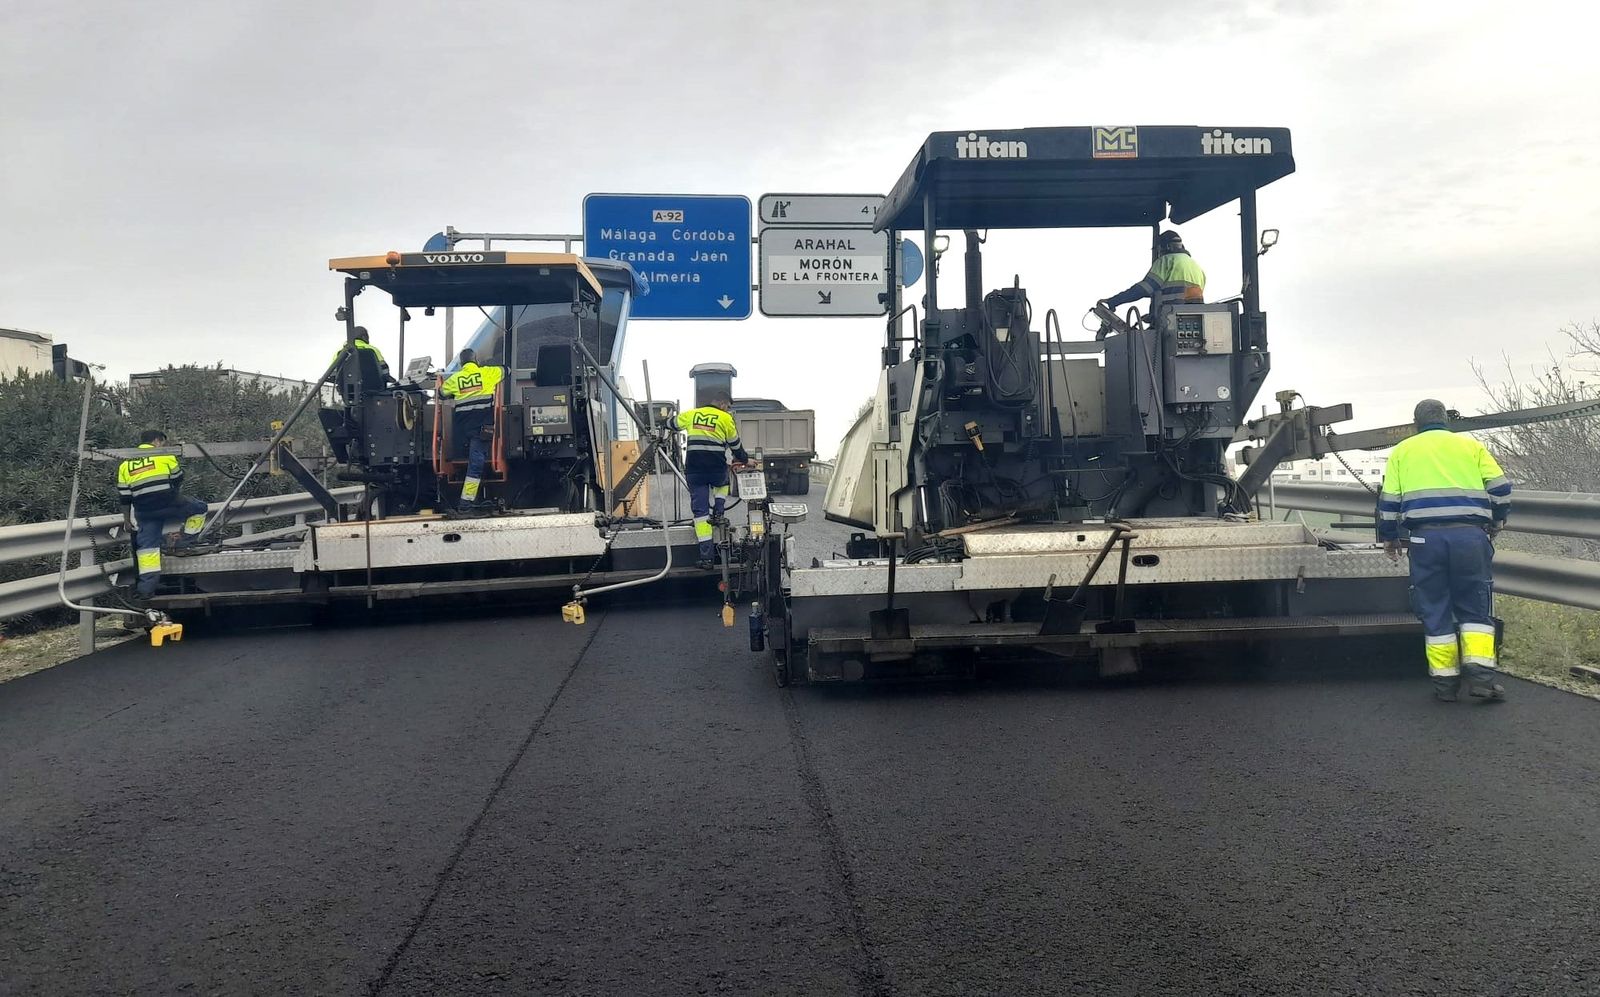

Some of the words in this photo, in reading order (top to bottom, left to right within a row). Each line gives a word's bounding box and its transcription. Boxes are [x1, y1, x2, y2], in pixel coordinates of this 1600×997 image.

[955, 132, 1028, 159] titan
[1201, 129, 1272, 155] titan
[654, 211, 683, 221] A-92
[601, 228, 657, 243] Málaga
[672, 228, 736, 242] Córdoba
[794, 239, 856, 250] ARAHAL
[424, 253, 484, 264] VOLVO
[608, 249, 675, 262] Granada
[690, 249, 728, 262] Jaén
[799, 256, 853, 270] MORÓN
[639, 271, 701, 283] Almería
[772, 272, 787, 281] DE
[794, 272, 810, 281] LA
[816, 272, 879, 281] FRONTERA
